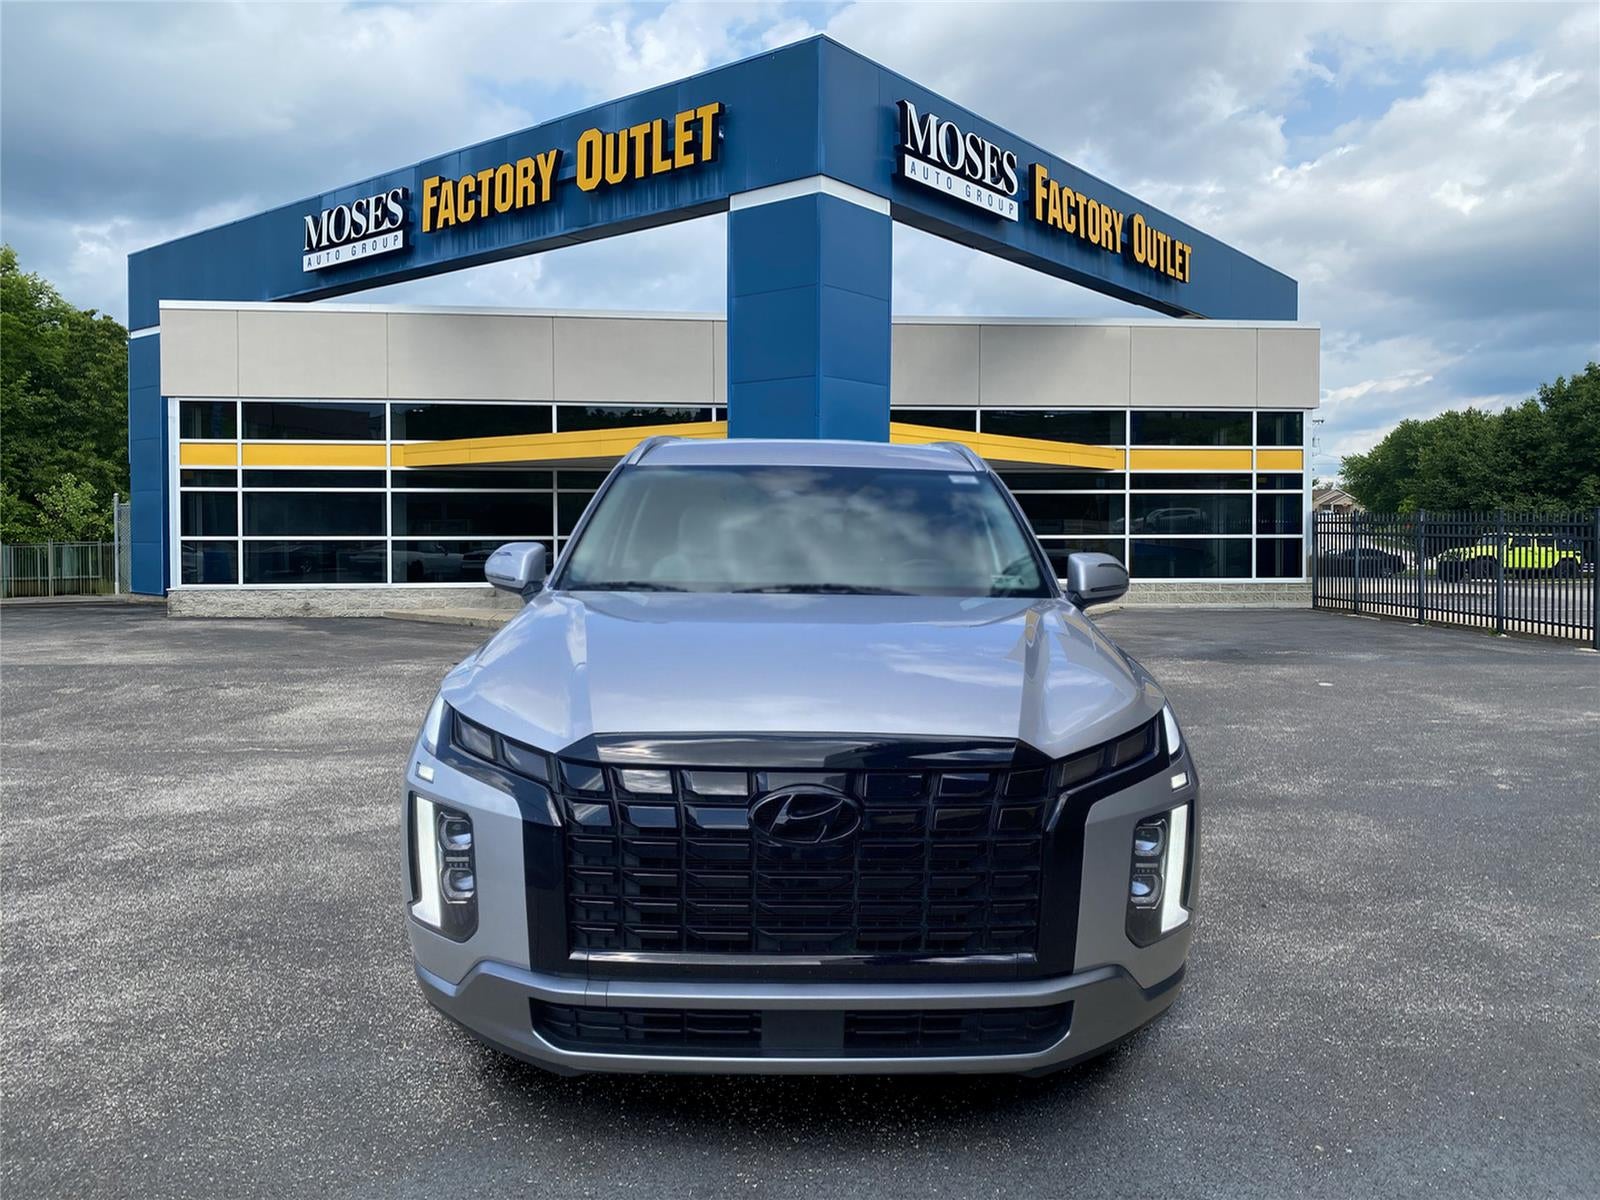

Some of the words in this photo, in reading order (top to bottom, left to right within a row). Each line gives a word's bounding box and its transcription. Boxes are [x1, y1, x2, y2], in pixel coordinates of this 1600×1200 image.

[422, 149, 558, 232] FACTORY
[576, 102, 720, 191] OUTLET
[903, 100, 1018, 196] MOSES
[910, 160, 952, 190] AUTO
[965, 185, 1015, 215] GROUP
[303, 188, 404, 251] MOSES
[307, 249, 341, 267] AUTO
[350, 234, 399, 255] GROUP
[1035, 162, 1123, 253] FACTORY
[1133, 215, 1192, 283] OUTLET
